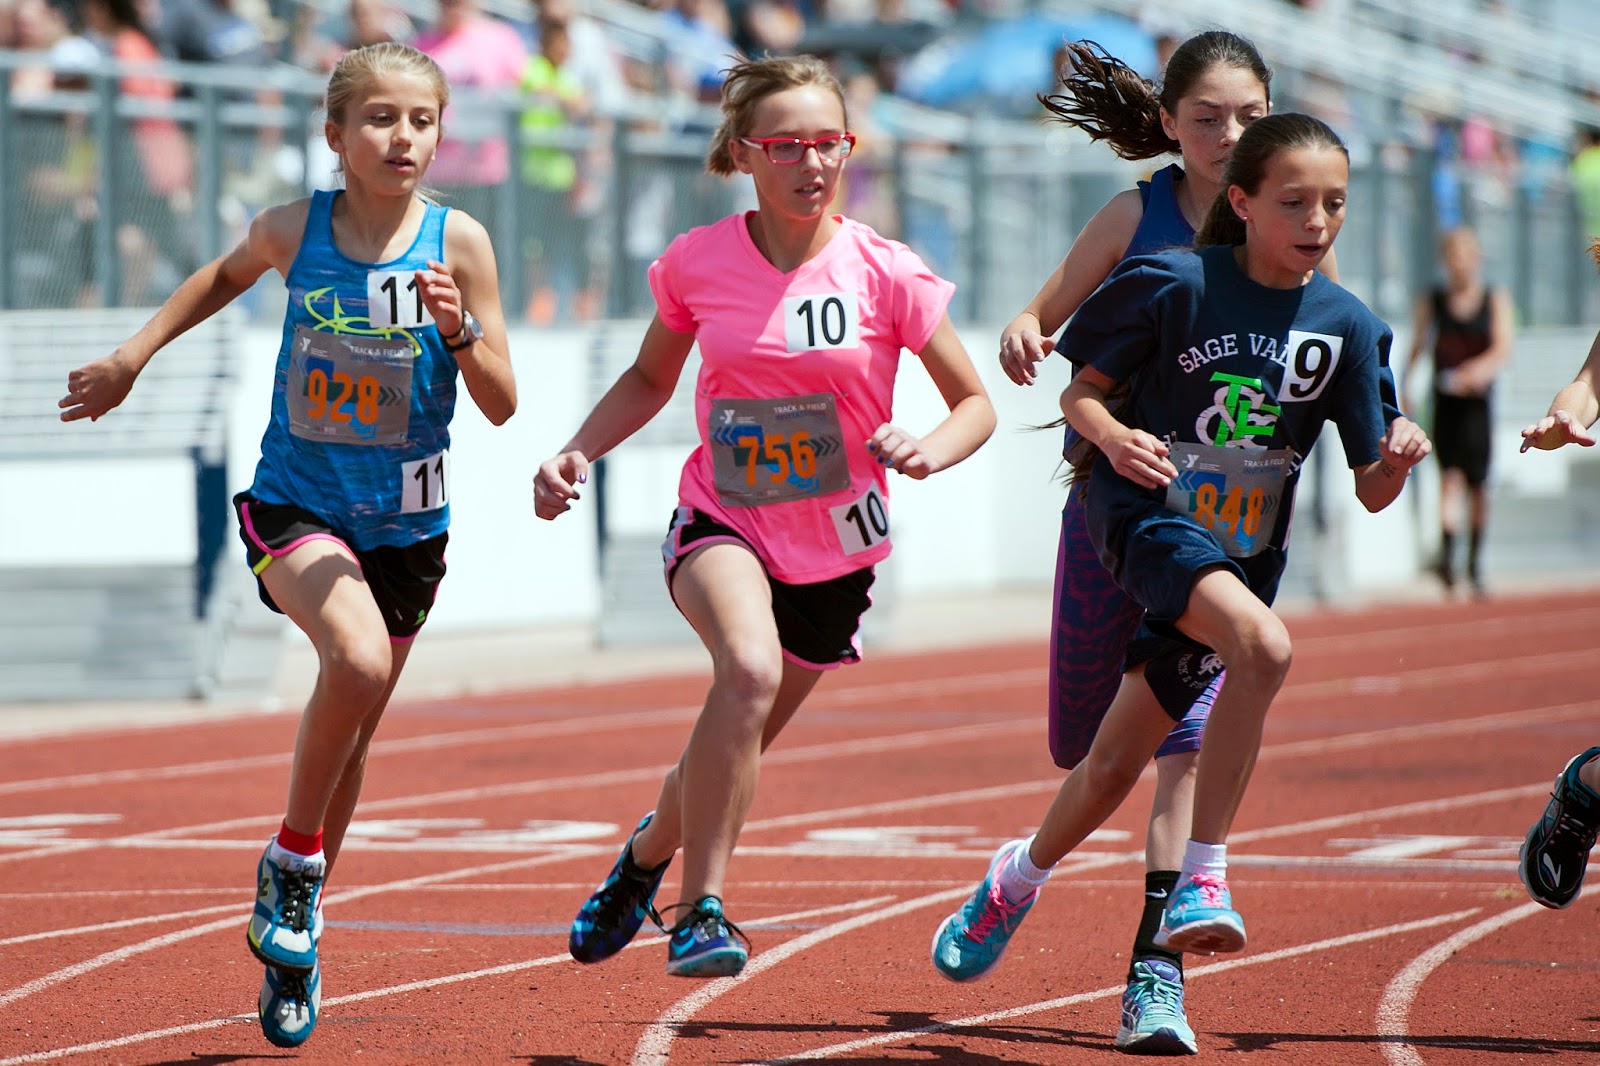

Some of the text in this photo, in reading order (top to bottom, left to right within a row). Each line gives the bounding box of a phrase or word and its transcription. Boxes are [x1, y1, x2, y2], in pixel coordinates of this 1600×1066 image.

[380, 276, 422, 325] 11
[796, 297, 846, 347] 10
[350, 345, 374, 356] TRACK
[1178, 333, 1239, 374] SAGE
[1289, 338, 1333, 399] 9
[307, 367, 379, 425] 928
[773, 405, 797, 414] TRACK
[807, 402, 827, 411] FIELD
[414, 455, 446, 508] 11
[738, 431, 816, 486] 756
[1243, 460, 1263, 468] TRACK
[1270, 458, 1285, 466] FIELD
[845, 491, 889, 547] 10
[1195, 482, 1264, 536] 848
